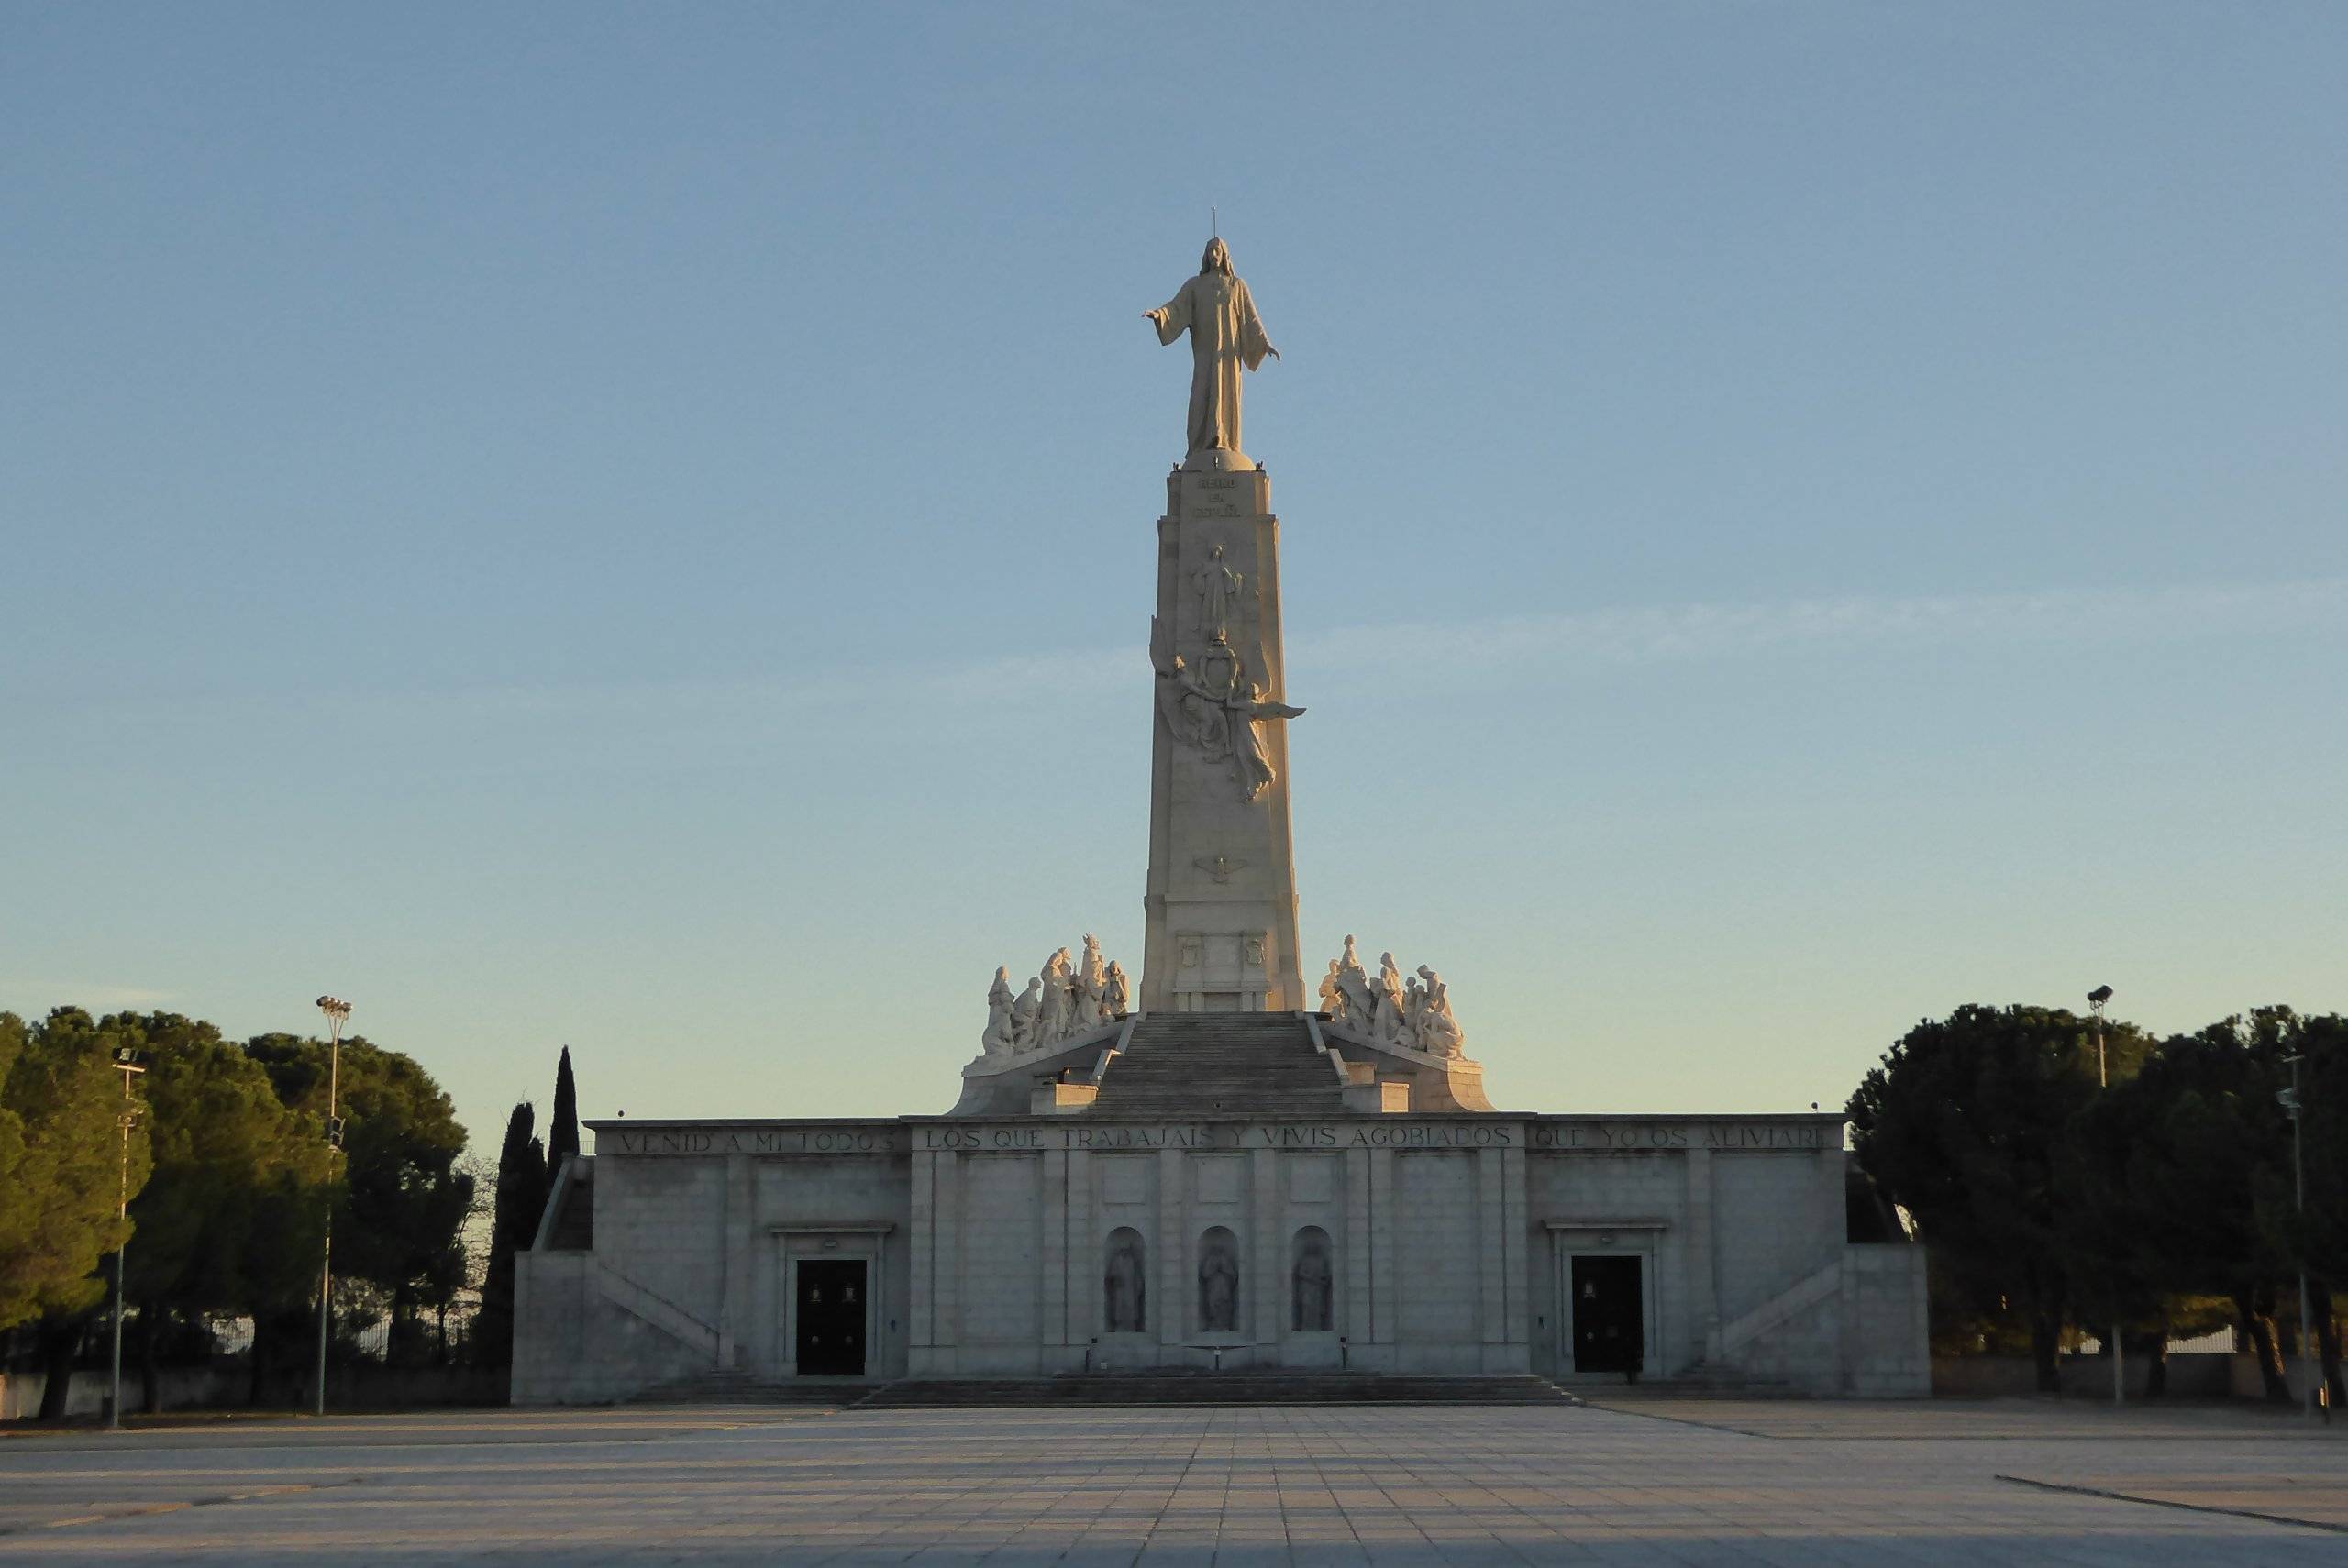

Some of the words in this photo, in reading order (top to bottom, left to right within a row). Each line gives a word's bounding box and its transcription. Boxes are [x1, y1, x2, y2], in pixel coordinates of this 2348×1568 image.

[620, 1133, 712, 1153] VENID
[726, 1134, 742, 1152] A
[755, 1133, 782, 1152] MI
[797, 1132, 895, 1151] TODOS
[926, 1130, 980, 1149] LOS
[993, 1129, 1045, 1149] QUE
[1060, 1128, 1216, 1148] TRABAJAIS
[1230, 1128, 1250, 1147] Y
[1262, 1127, 1337, 1146] VIVIS
[1351, 1127, 1512, 1146] AGOBIADOS
[1535, 1129, 1586, 1147] QUE
[1602, 1128, 1638, 1146] YO
[1651, 1129, 1688, 1146] OS
